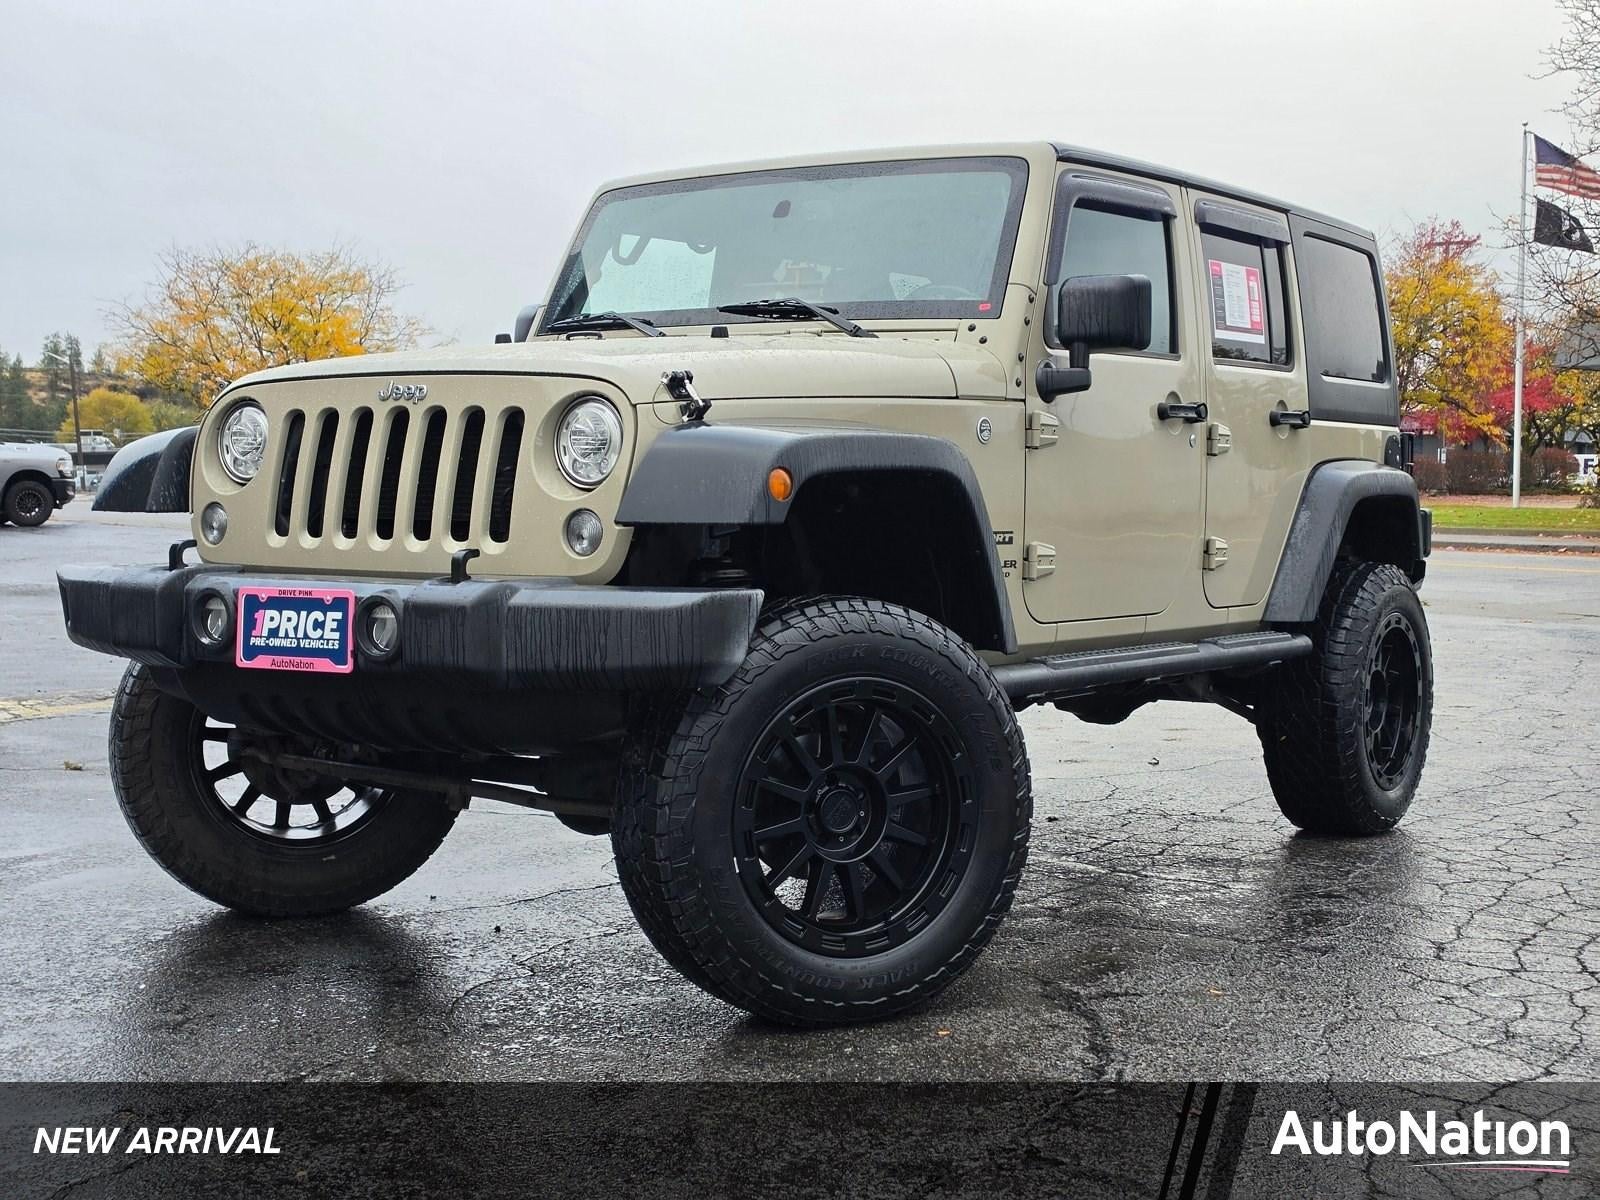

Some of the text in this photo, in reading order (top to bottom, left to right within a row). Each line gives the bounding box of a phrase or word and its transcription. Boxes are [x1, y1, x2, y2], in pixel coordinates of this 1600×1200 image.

[378, 380, 428, 405] Jeep
[278, 589, 297, 597] DRIVE
[251, 609, 343, 640] 1PRICE
[249, 637, 340, 650] PRE-OWNED VEHICLES
[270, 658, 315, 670] AutoNation
